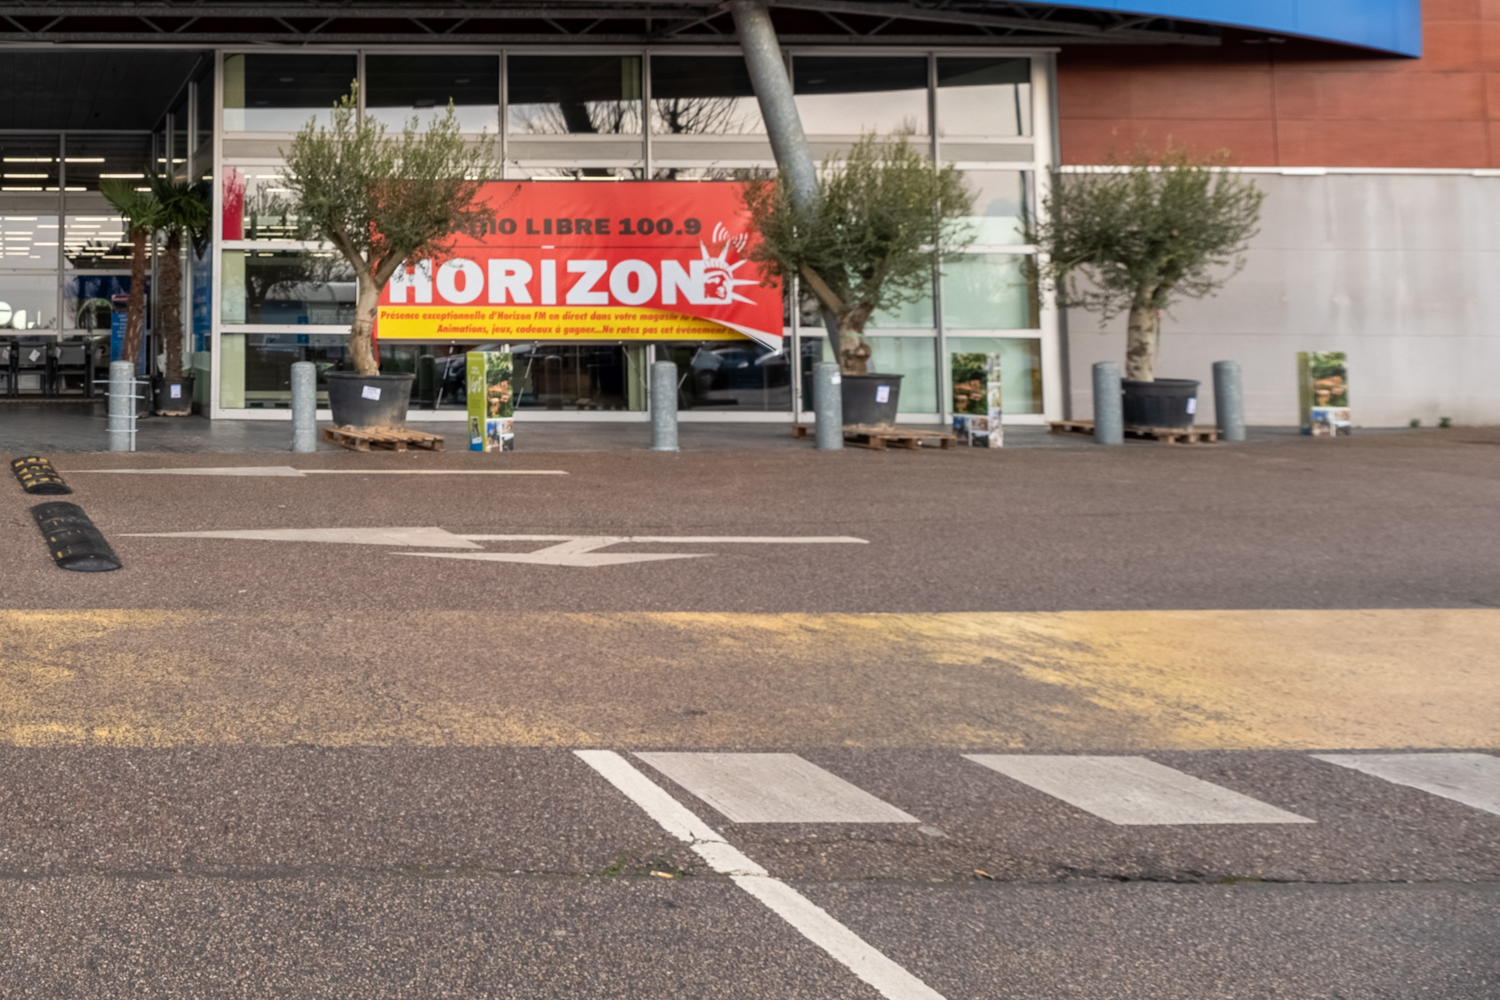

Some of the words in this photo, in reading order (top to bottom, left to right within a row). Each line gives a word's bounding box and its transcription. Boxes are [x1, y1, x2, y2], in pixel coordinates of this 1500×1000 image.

[525, 218, 611, 236] LIBRE
[618, 218, 702, 236] 100.9
[388, 258, 733, 306] HORIZON
[380, 311, 420, 320] Présence
[422, 311, 486, 322] exceptionnelle
[533, 312, 547, 321] FM
[562, 311, 589, 321] direct
[590, 311, 612, 321] dans
[614, 313, 638, 321] votre
[639, 312, 679, 322] magasin
[436, 324, 489, 334] Animations,
[491, 325, 513, 335] jeux,
[515, 324, 553, 334] cadeaux
[616, 326, 641, 334] ratez
[642, 327, 659, 336] pas
[660, 326, 674, 334] cet
